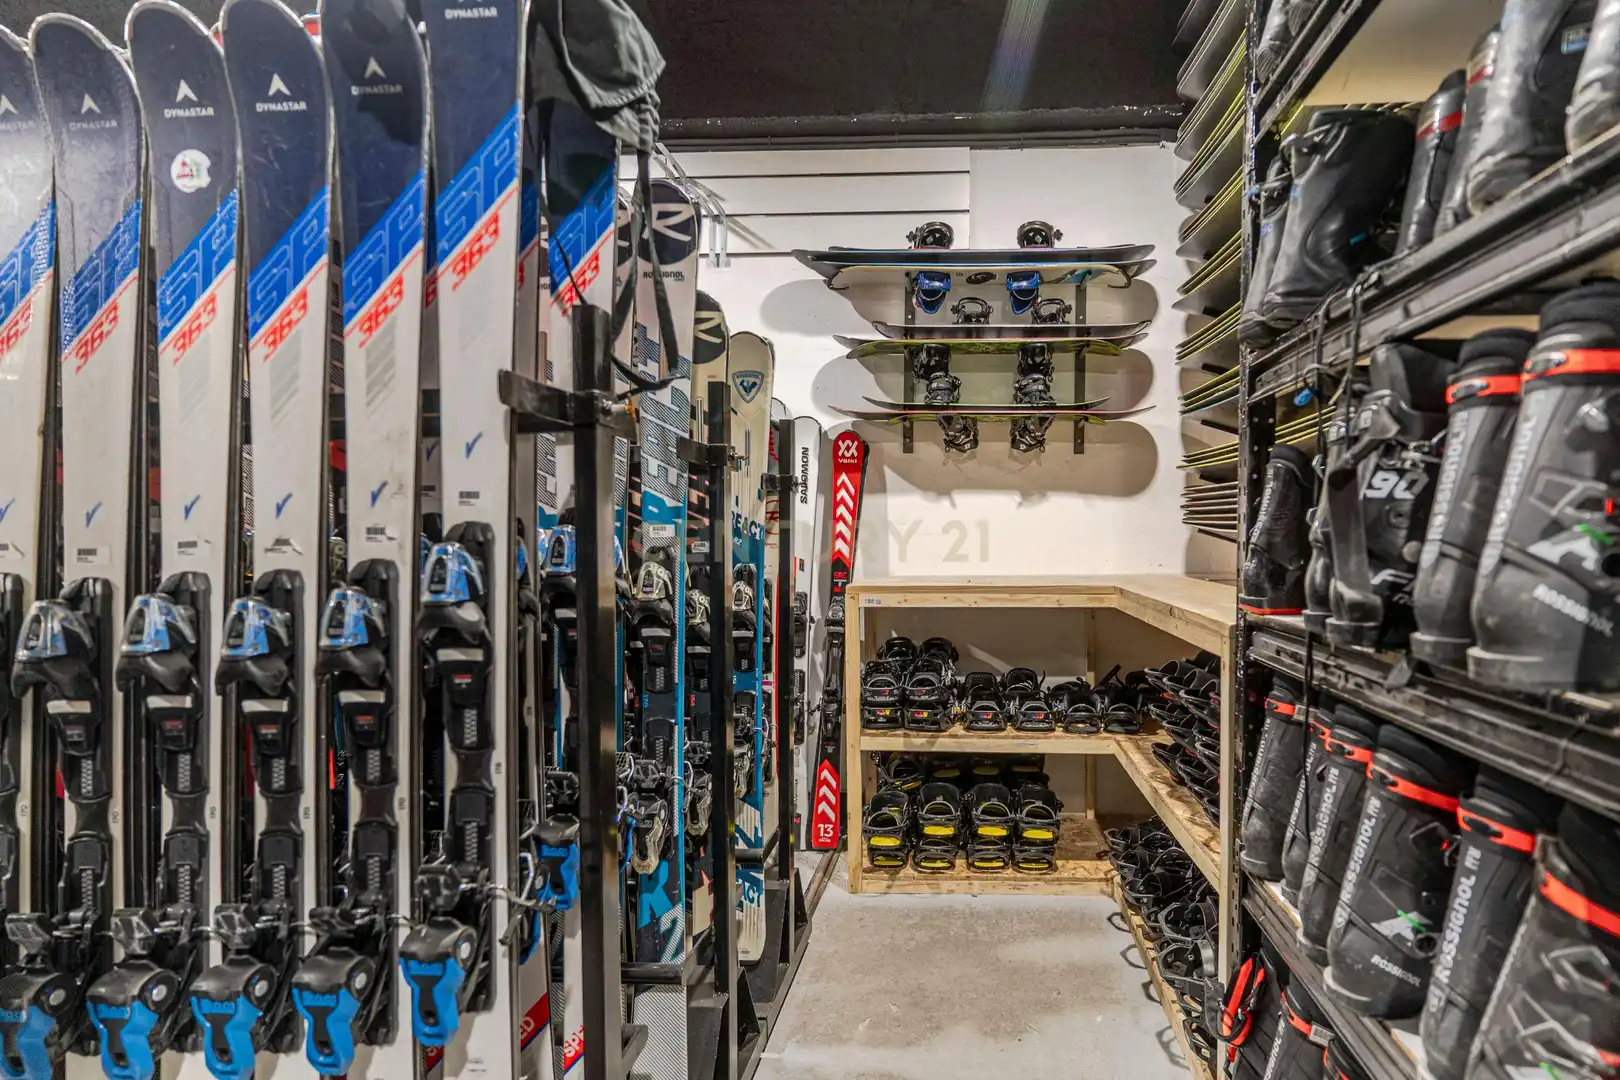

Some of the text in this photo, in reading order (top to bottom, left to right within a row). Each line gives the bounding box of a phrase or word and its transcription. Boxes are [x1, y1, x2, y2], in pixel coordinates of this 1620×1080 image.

[444, 7, 498, 20] DYNASTAR
[256, 101, 307, 113] DYNASTAR
[350, 84, 403, 96] DYNASTAR
[163, 107, 215, 119] DYNASTAR
[451, 210, 500, 291] 963
[643, 271, 685, 279] ROIGNOL
[173, 291, 217, 366] 963
[263, 285, 308, 363] 963
[358, 271, 404, 349] 963
[74, 298, 119, 376] 963
[800, 446, 810, 505] SALOMON
[1363, 470, 1430, 500] 90
[817, 823, 834, 838] 13
[1434, 873, 1476, 984] ROSSIGNOL
